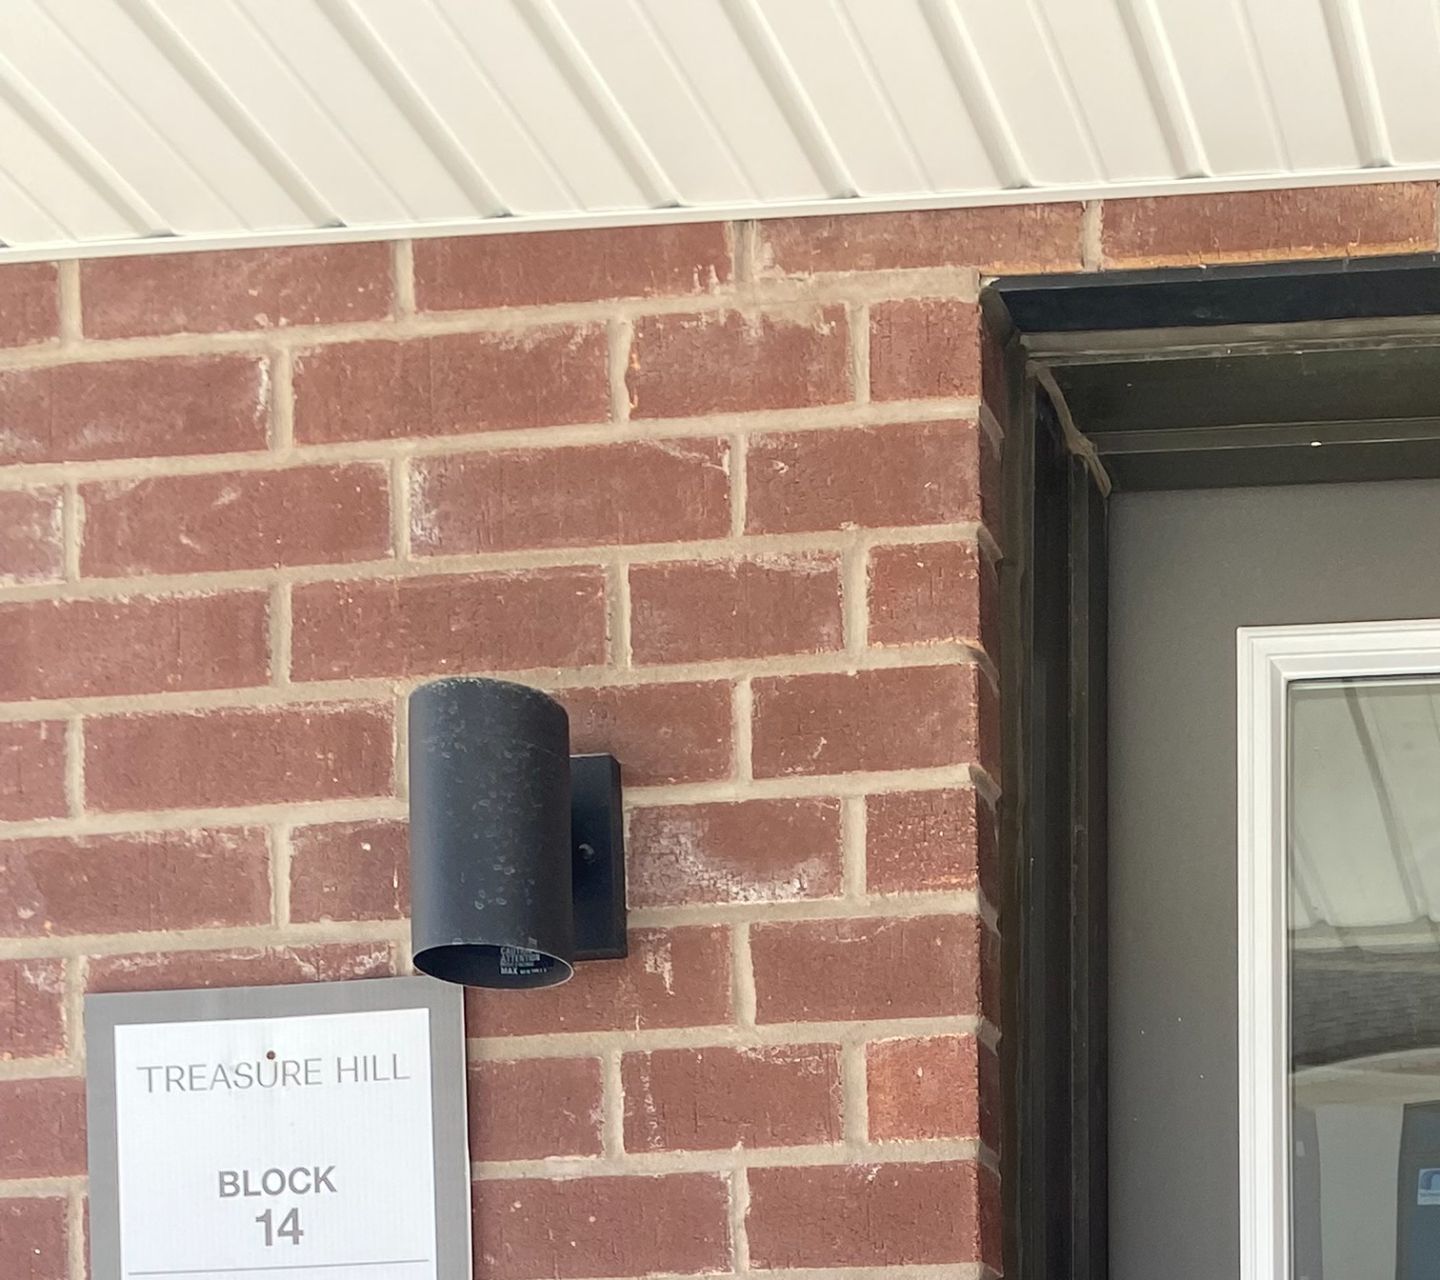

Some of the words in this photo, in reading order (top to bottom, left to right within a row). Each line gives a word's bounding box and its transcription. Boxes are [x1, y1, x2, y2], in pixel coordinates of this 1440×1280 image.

[136, 1057, 323, 1093] TREASURE
[336, 1053, 411, 1084] HILL
[218, 1166, 338, 1198] BLOCK
[255, 1207, 305, 1247] 14
